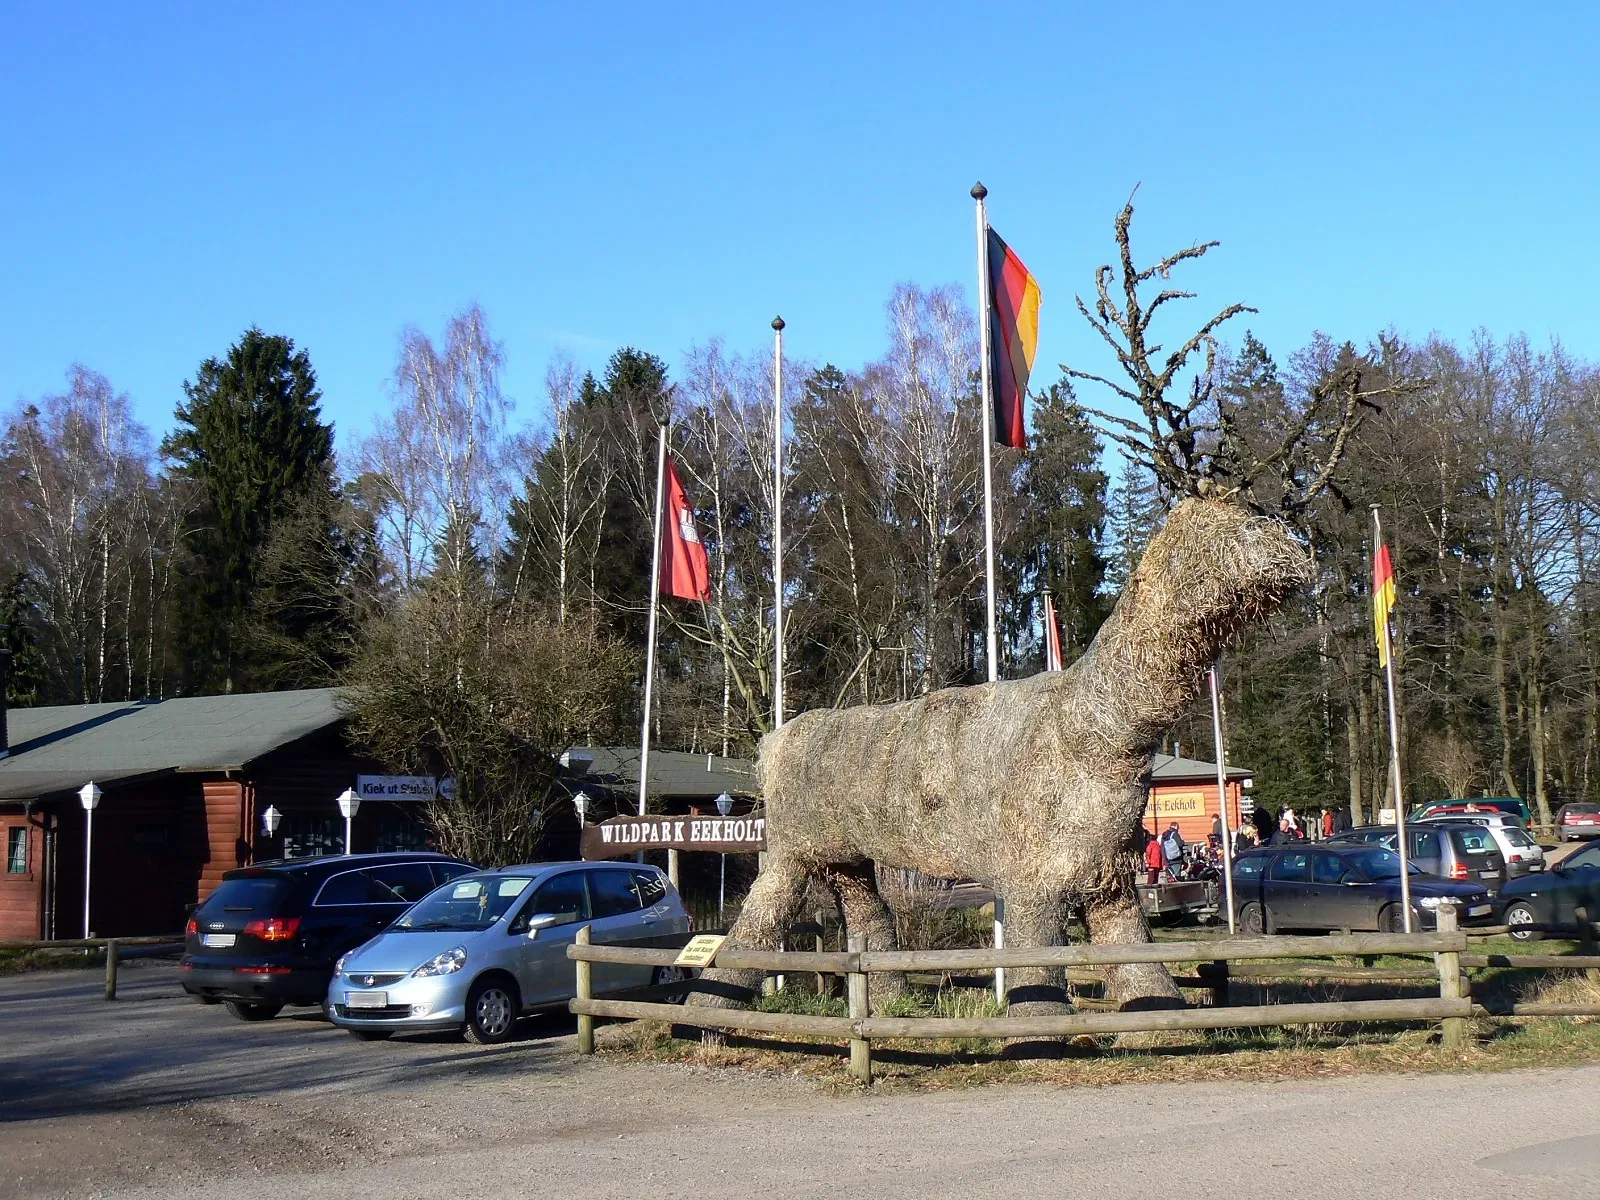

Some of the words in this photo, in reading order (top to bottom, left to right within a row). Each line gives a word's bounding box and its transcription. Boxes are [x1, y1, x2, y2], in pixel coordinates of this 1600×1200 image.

[363, 783, 385, 794] Kiek
[388, 784, 398, 794] ut
[601, 822, 685, 843] WILDPARK
[690, 818, 765, 842] EEKHOLT
